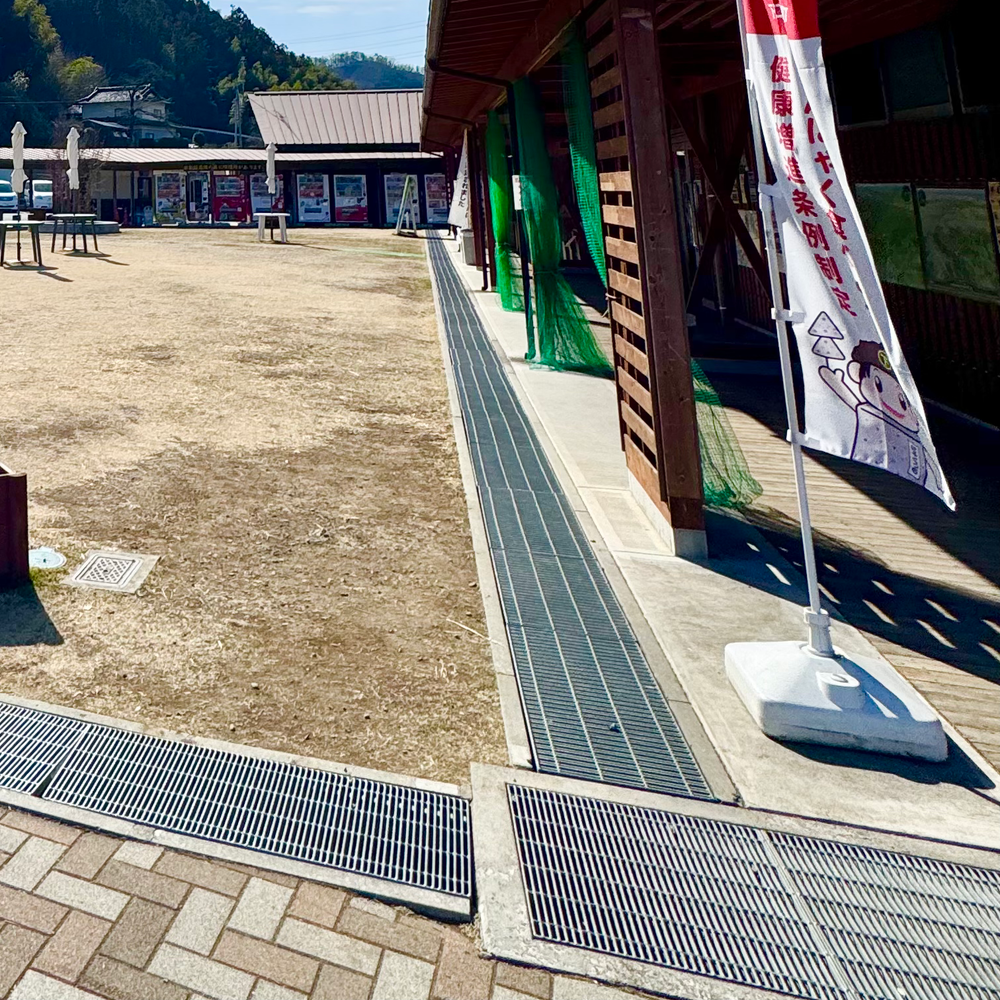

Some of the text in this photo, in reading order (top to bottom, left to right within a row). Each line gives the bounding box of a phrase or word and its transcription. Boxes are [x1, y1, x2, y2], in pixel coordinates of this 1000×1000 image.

[769, 55, 858, 317] 健康増進条例制定
